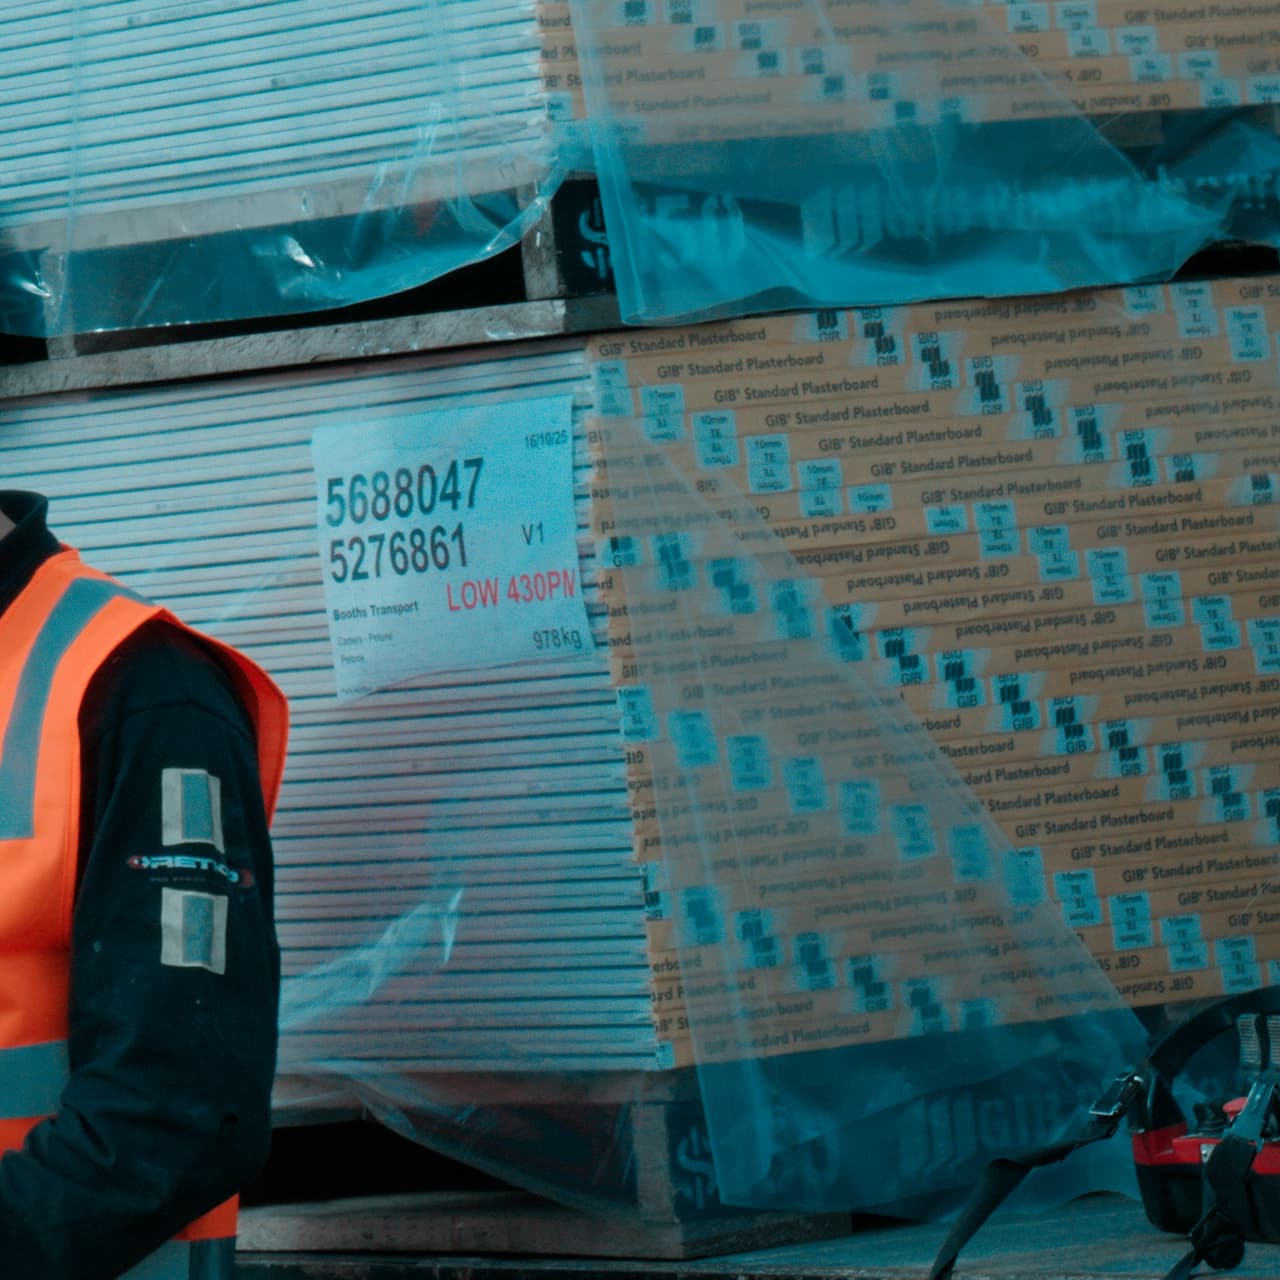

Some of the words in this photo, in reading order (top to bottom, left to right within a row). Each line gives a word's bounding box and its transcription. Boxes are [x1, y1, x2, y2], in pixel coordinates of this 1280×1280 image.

[630, 335, 684, 352] Standard
[688, 328, 766, 346] Plasterboard
[688, 359, 742, 376] Standard
[746, 353, 824, 370] Plasterboard
[745, 383, 799, 400] Standard
[802, 376, 879, 396] Plasterboard
[795, 409, 849, 425] Standard
[853, 401, 930, 419] Plasterboard
[849, 433, 902, 449] Standard
[907, 425, 982, 441] Plasterboard
[901, 458, 954, 474] Standard
[958, 449, 1033, 467] Plasterboard
[325, 457, 484, 527] 5688047
[951, 484, 1003, 501] Standard
[1007, 478, 1082, 494] Plasterboard
[1073, 495, 1125, 511] Standard
[1129, 489, 1202, 506] Plasterboard
[1126, 520, 1178, 536] Standard
[1182, 513, 1254, 530] Plasterboard
[329, 522, 468, 584] 5276861
[446, 579, 500, 612] LOW
[507, 569, 576, 604] 430PN
[333, 607, 368, 621] Booths
[369, 600, 419, 616] Transport
[532, 628, 582, 651] 978kg
